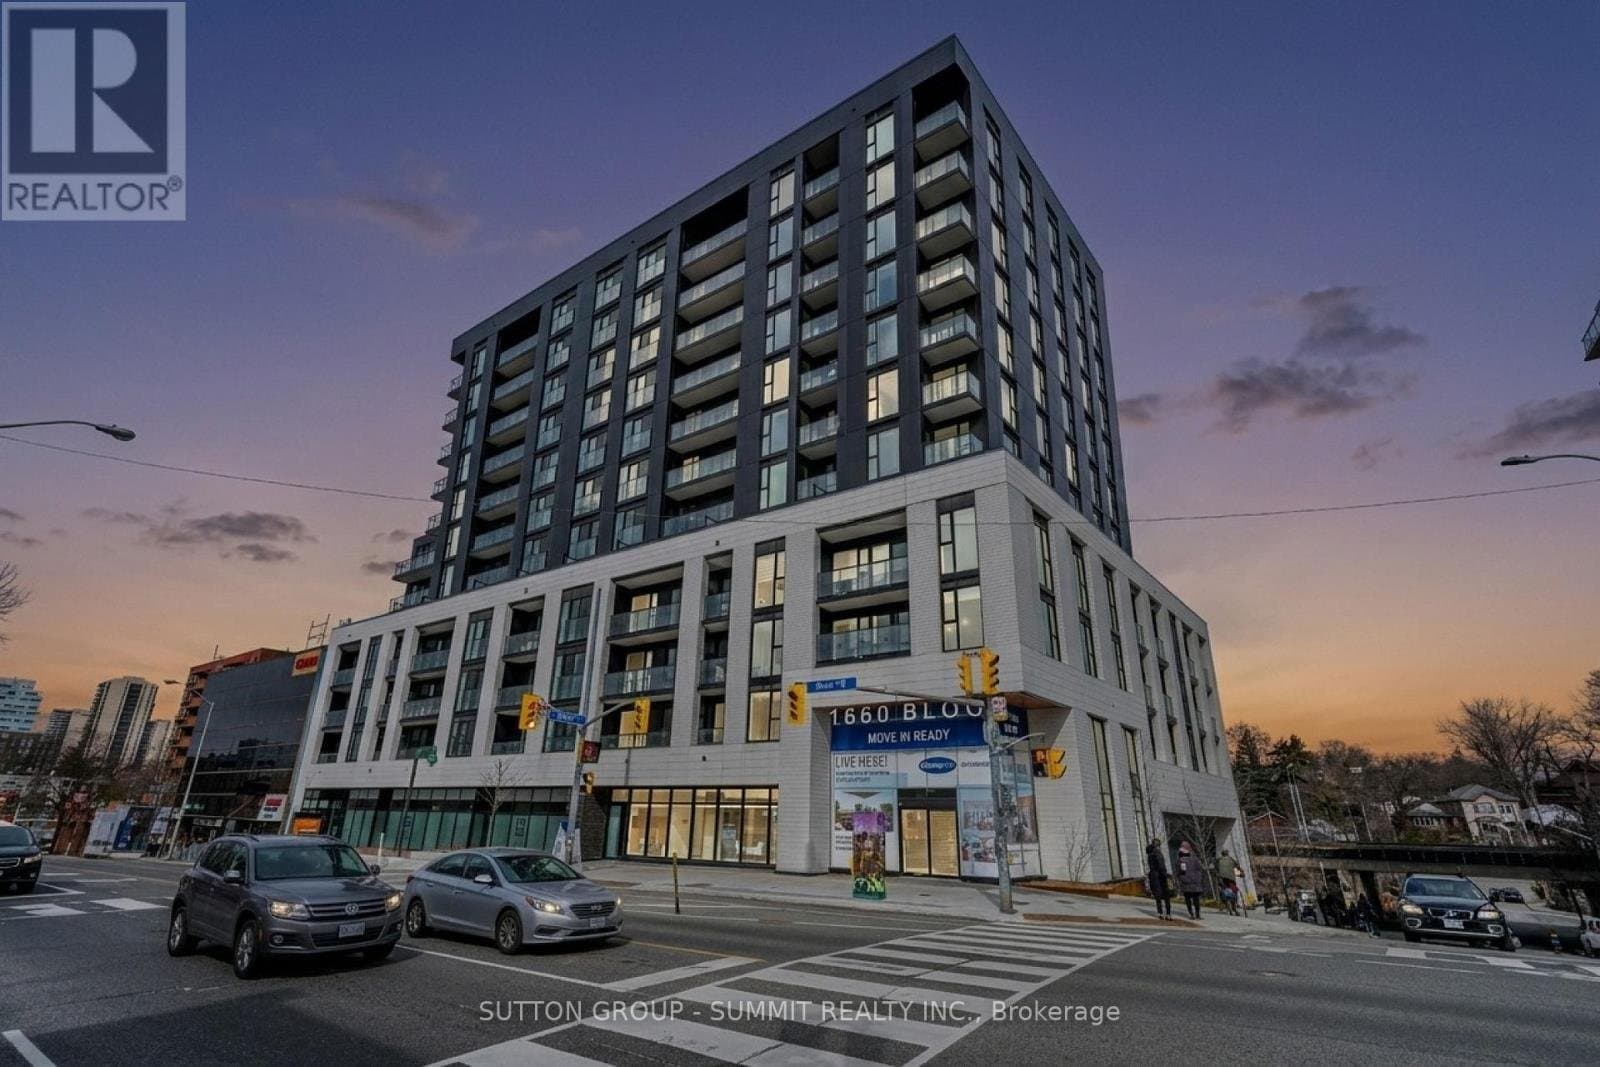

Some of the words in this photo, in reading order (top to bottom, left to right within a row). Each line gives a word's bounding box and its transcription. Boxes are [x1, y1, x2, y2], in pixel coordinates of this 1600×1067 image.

[829, 705, 889, 726] 1660
[867, 731, 897, 745] MOVE
[900, 731, 911, 743] IN
[913, 728, 950, 742] READY
[835, 755, 856, 769] LIVE
